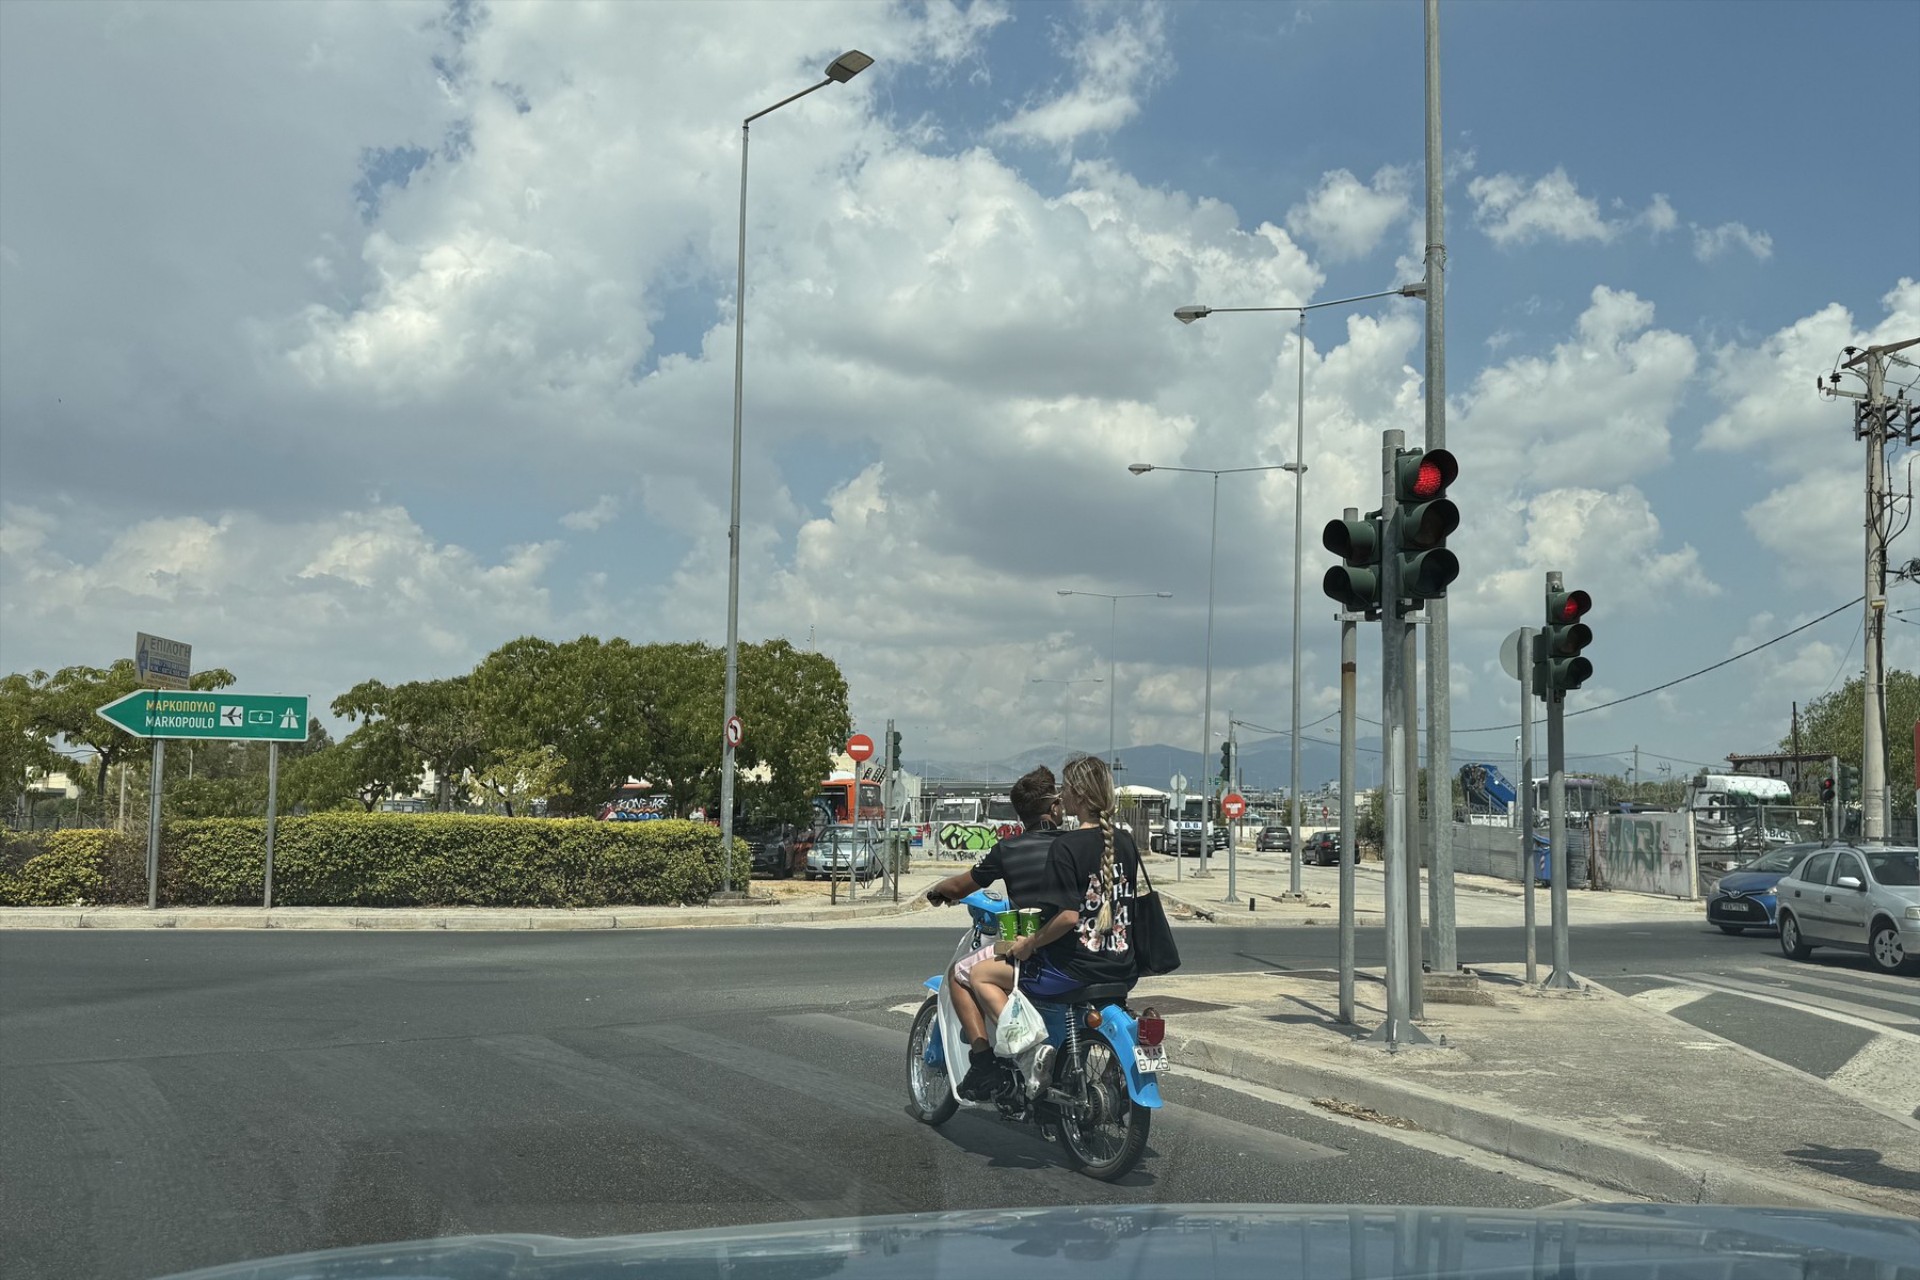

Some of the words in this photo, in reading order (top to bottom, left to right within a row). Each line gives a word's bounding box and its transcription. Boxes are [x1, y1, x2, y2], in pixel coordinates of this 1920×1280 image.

[151, 638, 191, 658] ΕΠΙΛΟΓΗ
[146, 700, 215, 713] ΜΑΡΚΟΠΟΥΛΟ
[145, 716, 215, 729] MARKOPOULO
[258, 713, 263, 721] 6
[1139, 1058, 1168, 1070] 8726
